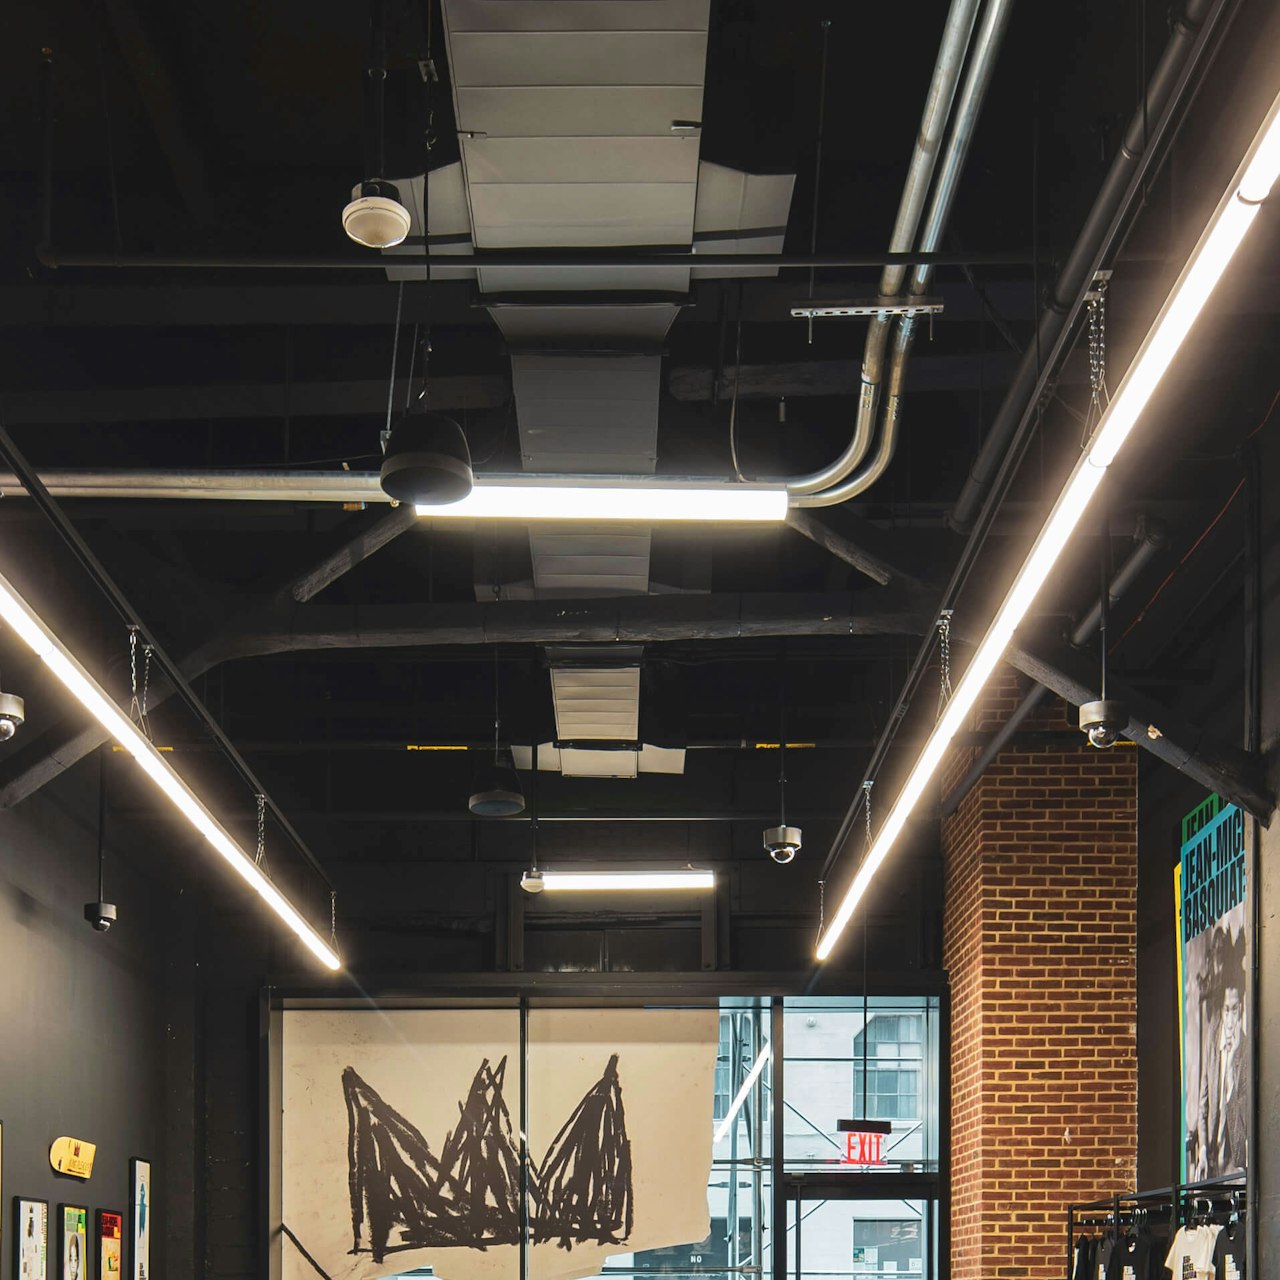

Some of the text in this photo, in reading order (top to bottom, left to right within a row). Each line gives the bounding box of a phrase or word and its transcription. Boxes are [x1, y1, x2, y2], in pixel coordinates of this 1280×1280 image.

[1184, 808, 1245, 900] JEAN-MIC
[846, 1132, 883, 1164] EXIT
[690, 1255, 702, 1263] NO
